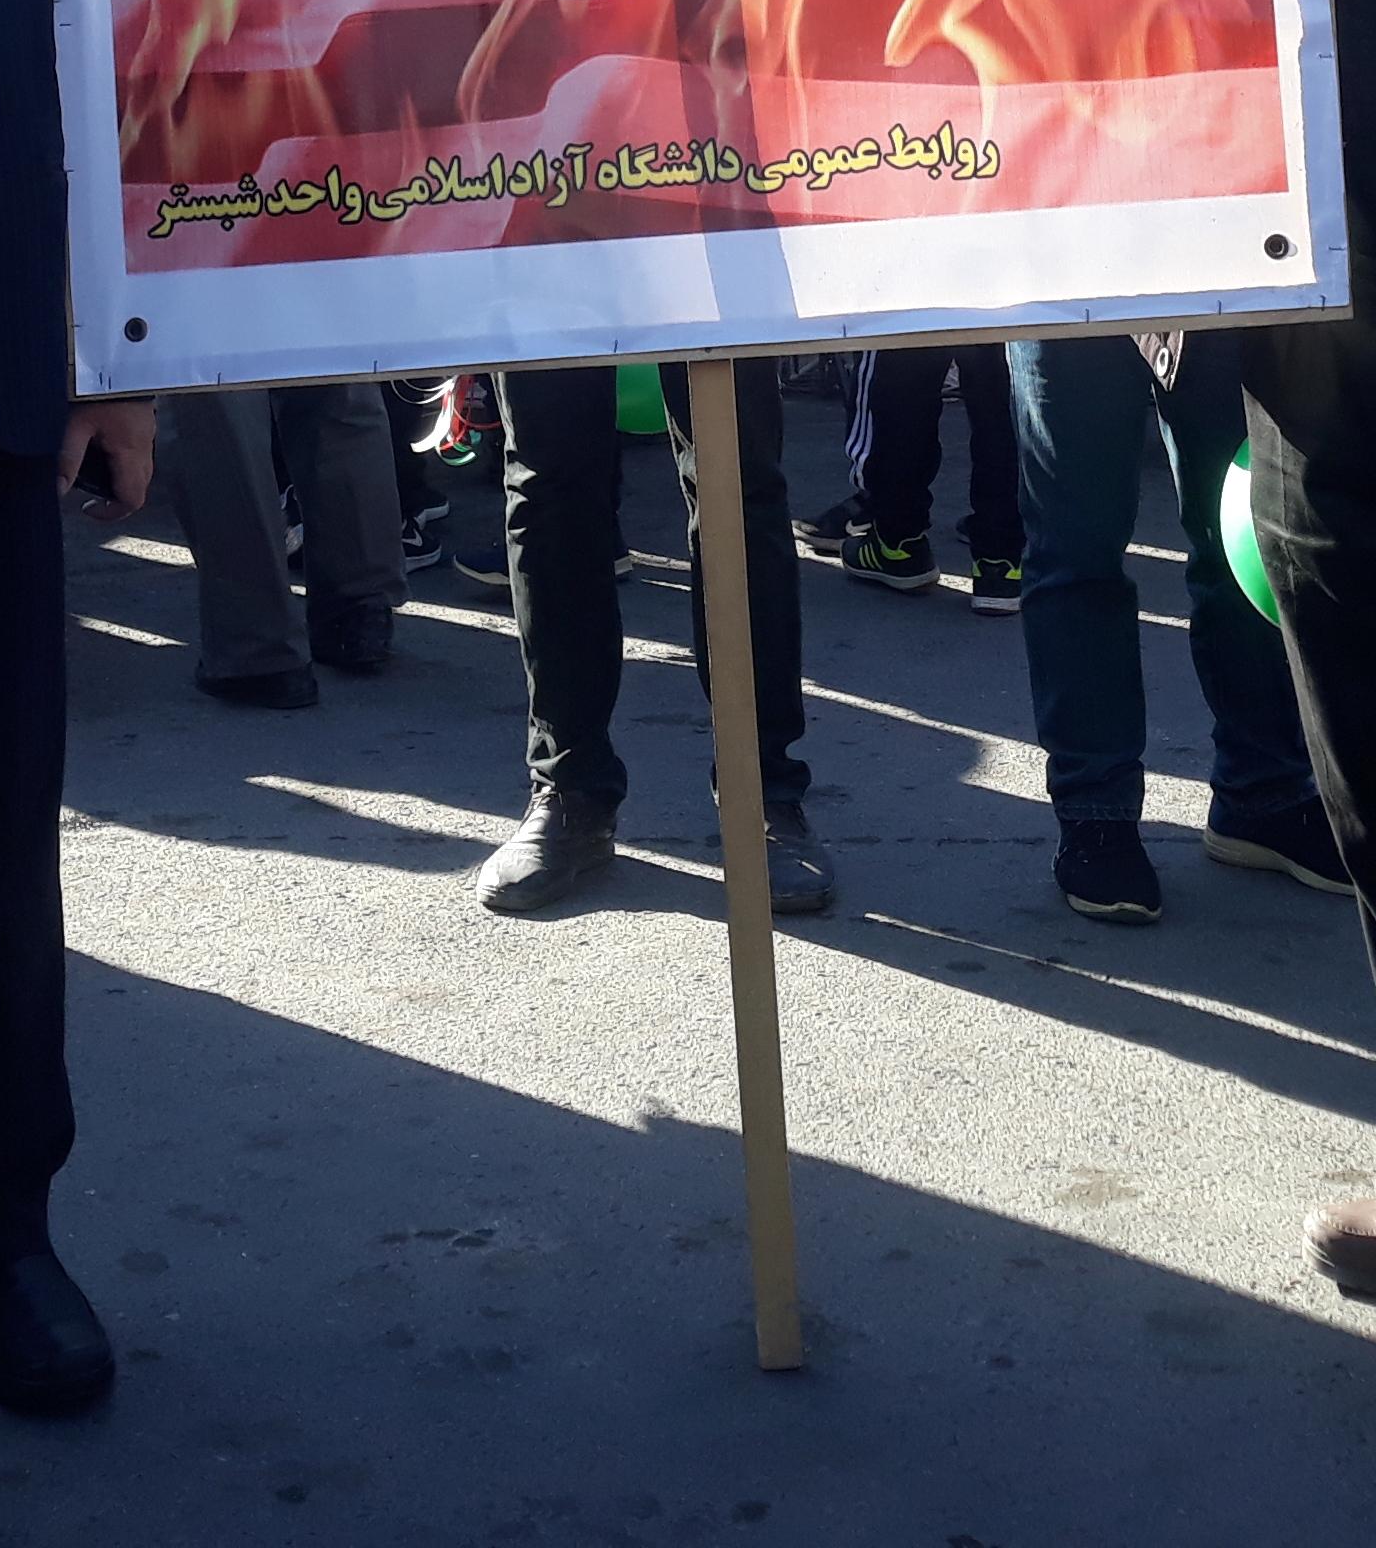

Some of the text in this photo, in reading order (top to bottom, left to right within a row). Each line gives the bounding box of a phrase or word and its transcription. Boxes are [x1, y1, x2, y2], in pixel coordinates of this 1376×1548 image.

[148, 120, 1001, 238] روابط عمومی دانشگاه آزاد اسلامی واحد شبستر
